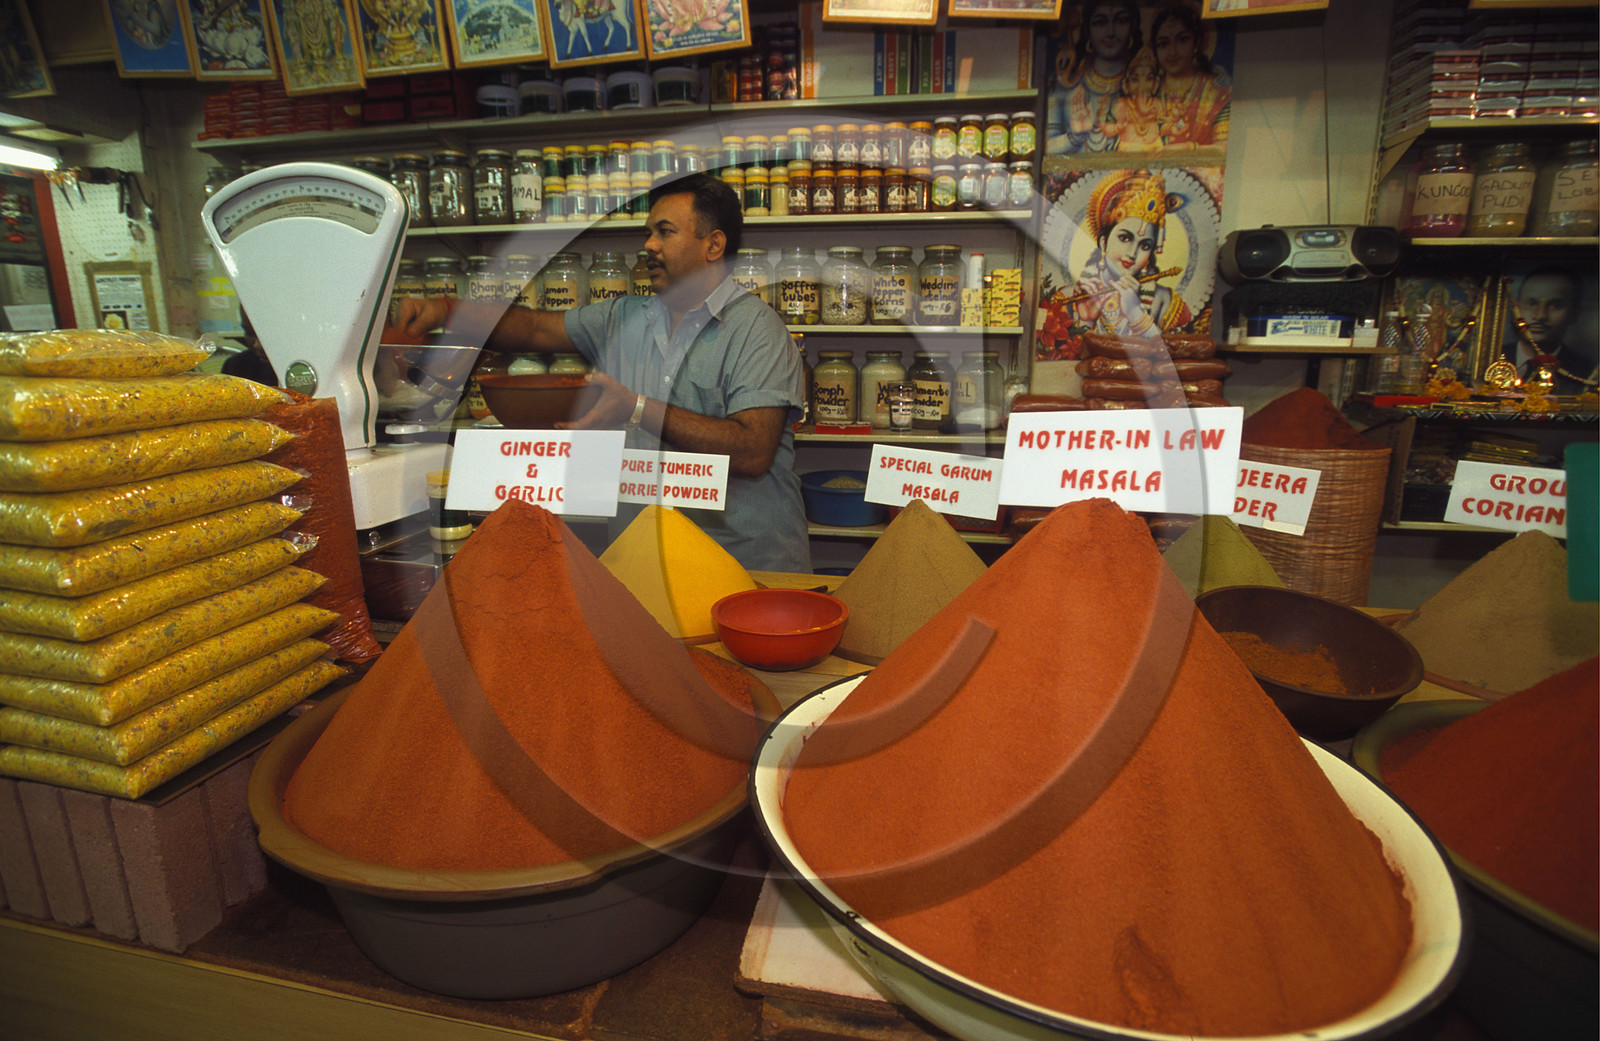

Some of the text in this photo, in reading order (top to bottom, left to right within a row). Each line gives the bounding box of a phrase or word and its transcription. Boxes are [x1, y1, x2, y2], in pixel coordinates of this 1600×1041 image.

[873, 287, 907, 299] Pepper
[920, 277, 959, 293] Wedding
[781, 290, 816, 302] tubes
[912, 395, 944, 407] owder
[1018, 428, 1225, 452] MOTHER-IN LAW
[500, 441, 572, 458] GINGER
[526, 463, 539, 479] &
[621, 459, 713, 477] PURE TUMERIC
[880, 456, 993, 482] SPECIAL GARUM
[619, 482, 658, 497] ORRIE
[1060, 469, 1162, 493] MASALA
[1237, 467, 1309, 495] JEERA
[495, 484, 565, 502] GARLIC
[663, 485, 719, 502] POWDER
[901, 484, 960, 504] MASALA
